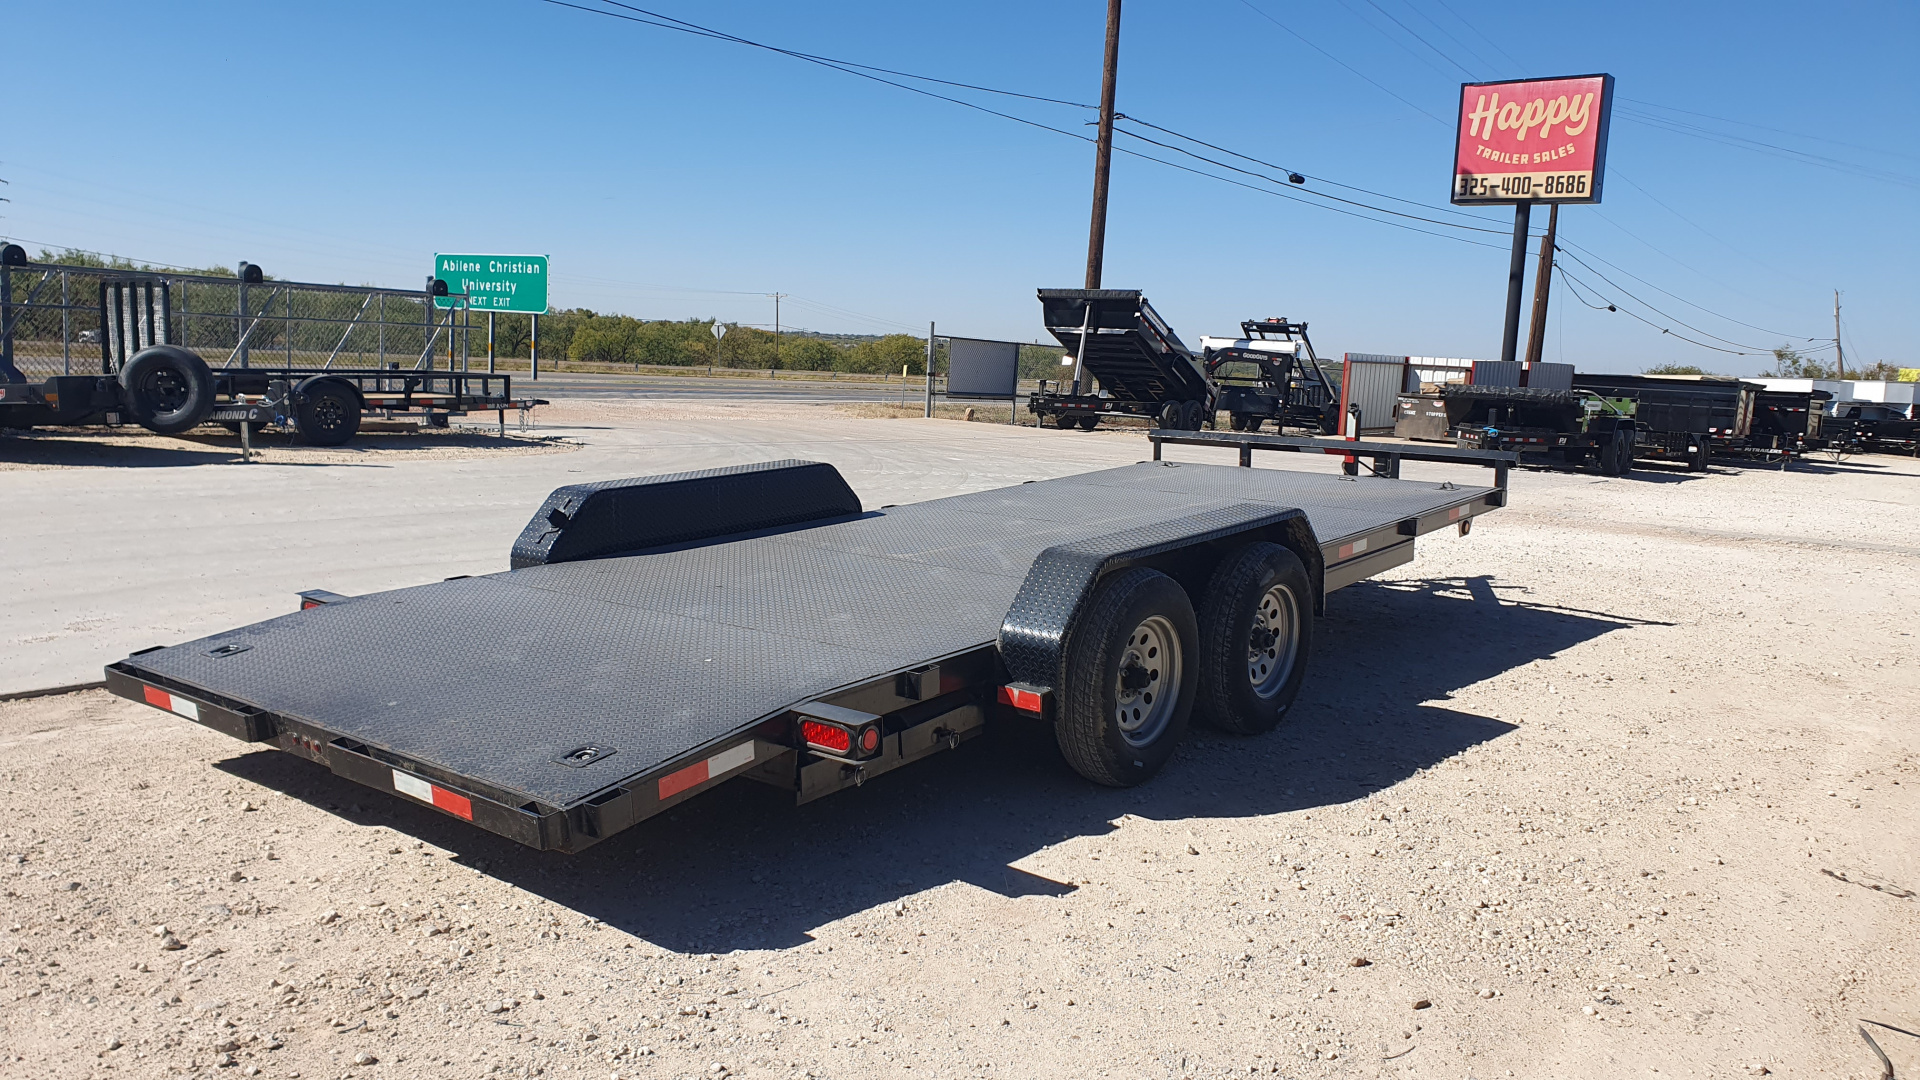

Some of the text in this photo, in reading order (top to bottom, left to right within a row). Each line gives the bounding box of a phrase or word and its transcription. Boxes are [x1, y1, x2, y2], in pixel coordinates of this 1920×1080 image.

[1468, 92, 1594, 141] Happy
[1476, 143, 1576, 165] TRAILER SALES
[1459, 175, 1586, 196] 325-400-8686
[442, 259, 540, 274] Abilene Christian
[461, 278, 517, 295] University
[493, 297, 511, 307] EXIT
[209, 408, 258, 420] AMOND C
